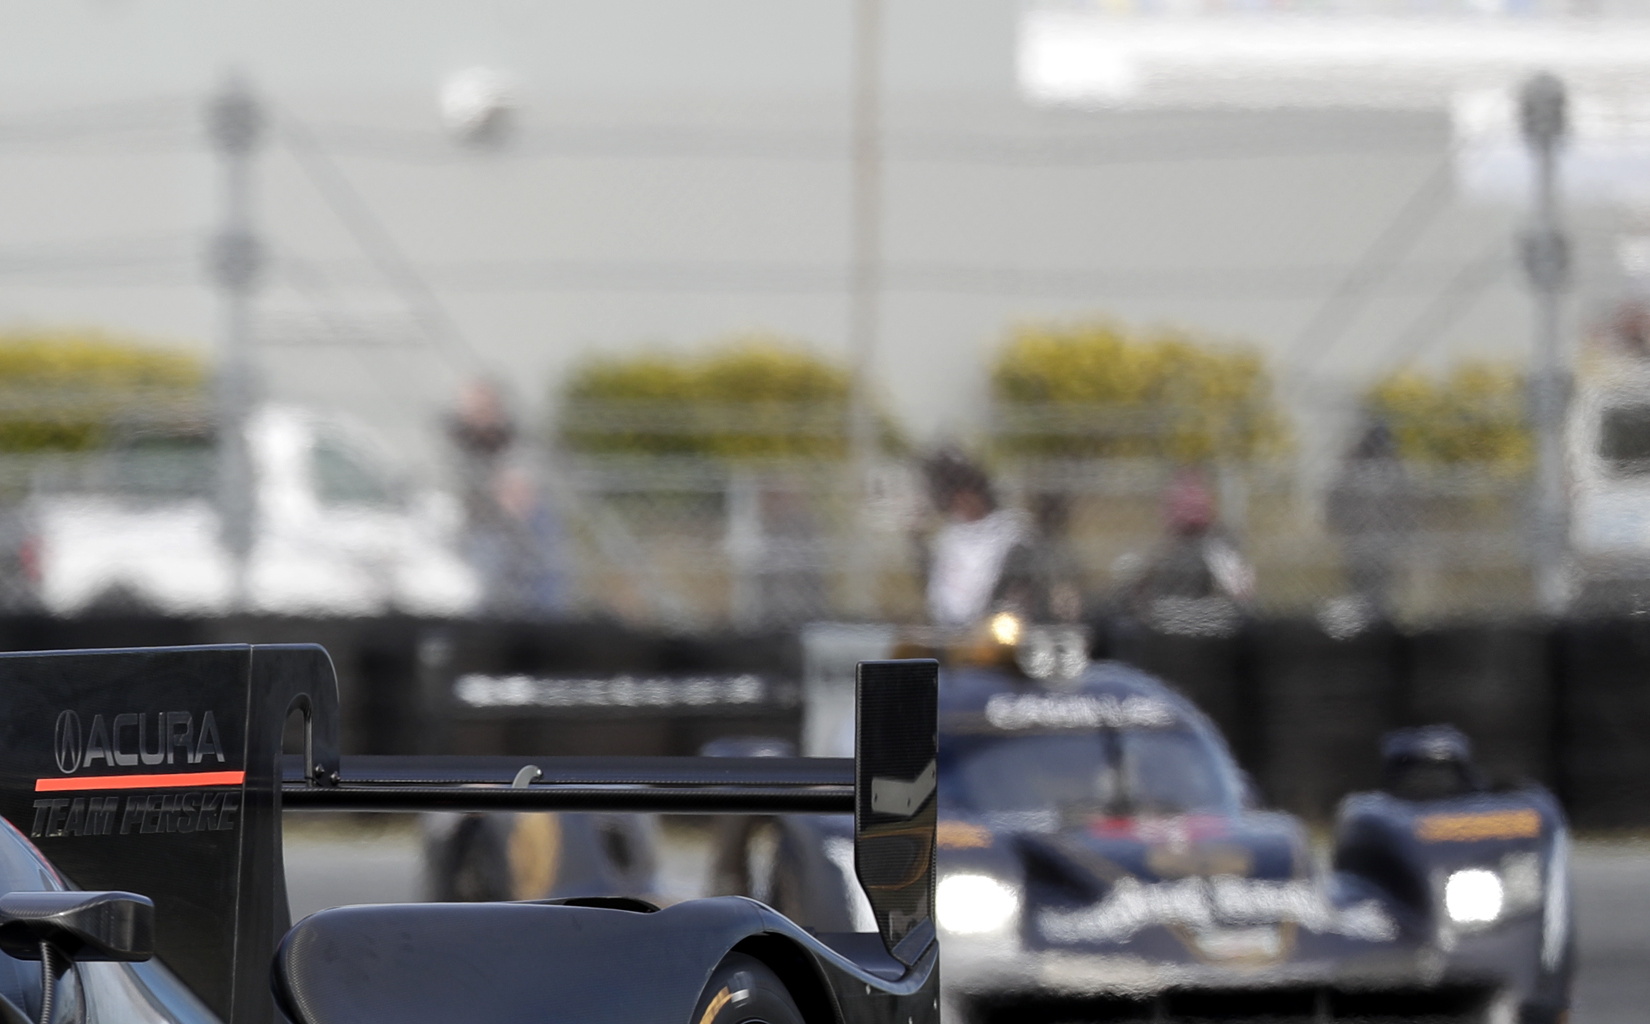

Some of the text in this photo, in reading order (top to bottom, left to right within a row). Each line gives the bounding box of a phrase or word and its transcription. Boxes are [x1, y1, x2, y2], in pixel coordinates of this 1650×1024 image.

[83, 711, 225, 767] ACURA
[31, 792, 240, 837] TEAM PENSKE
